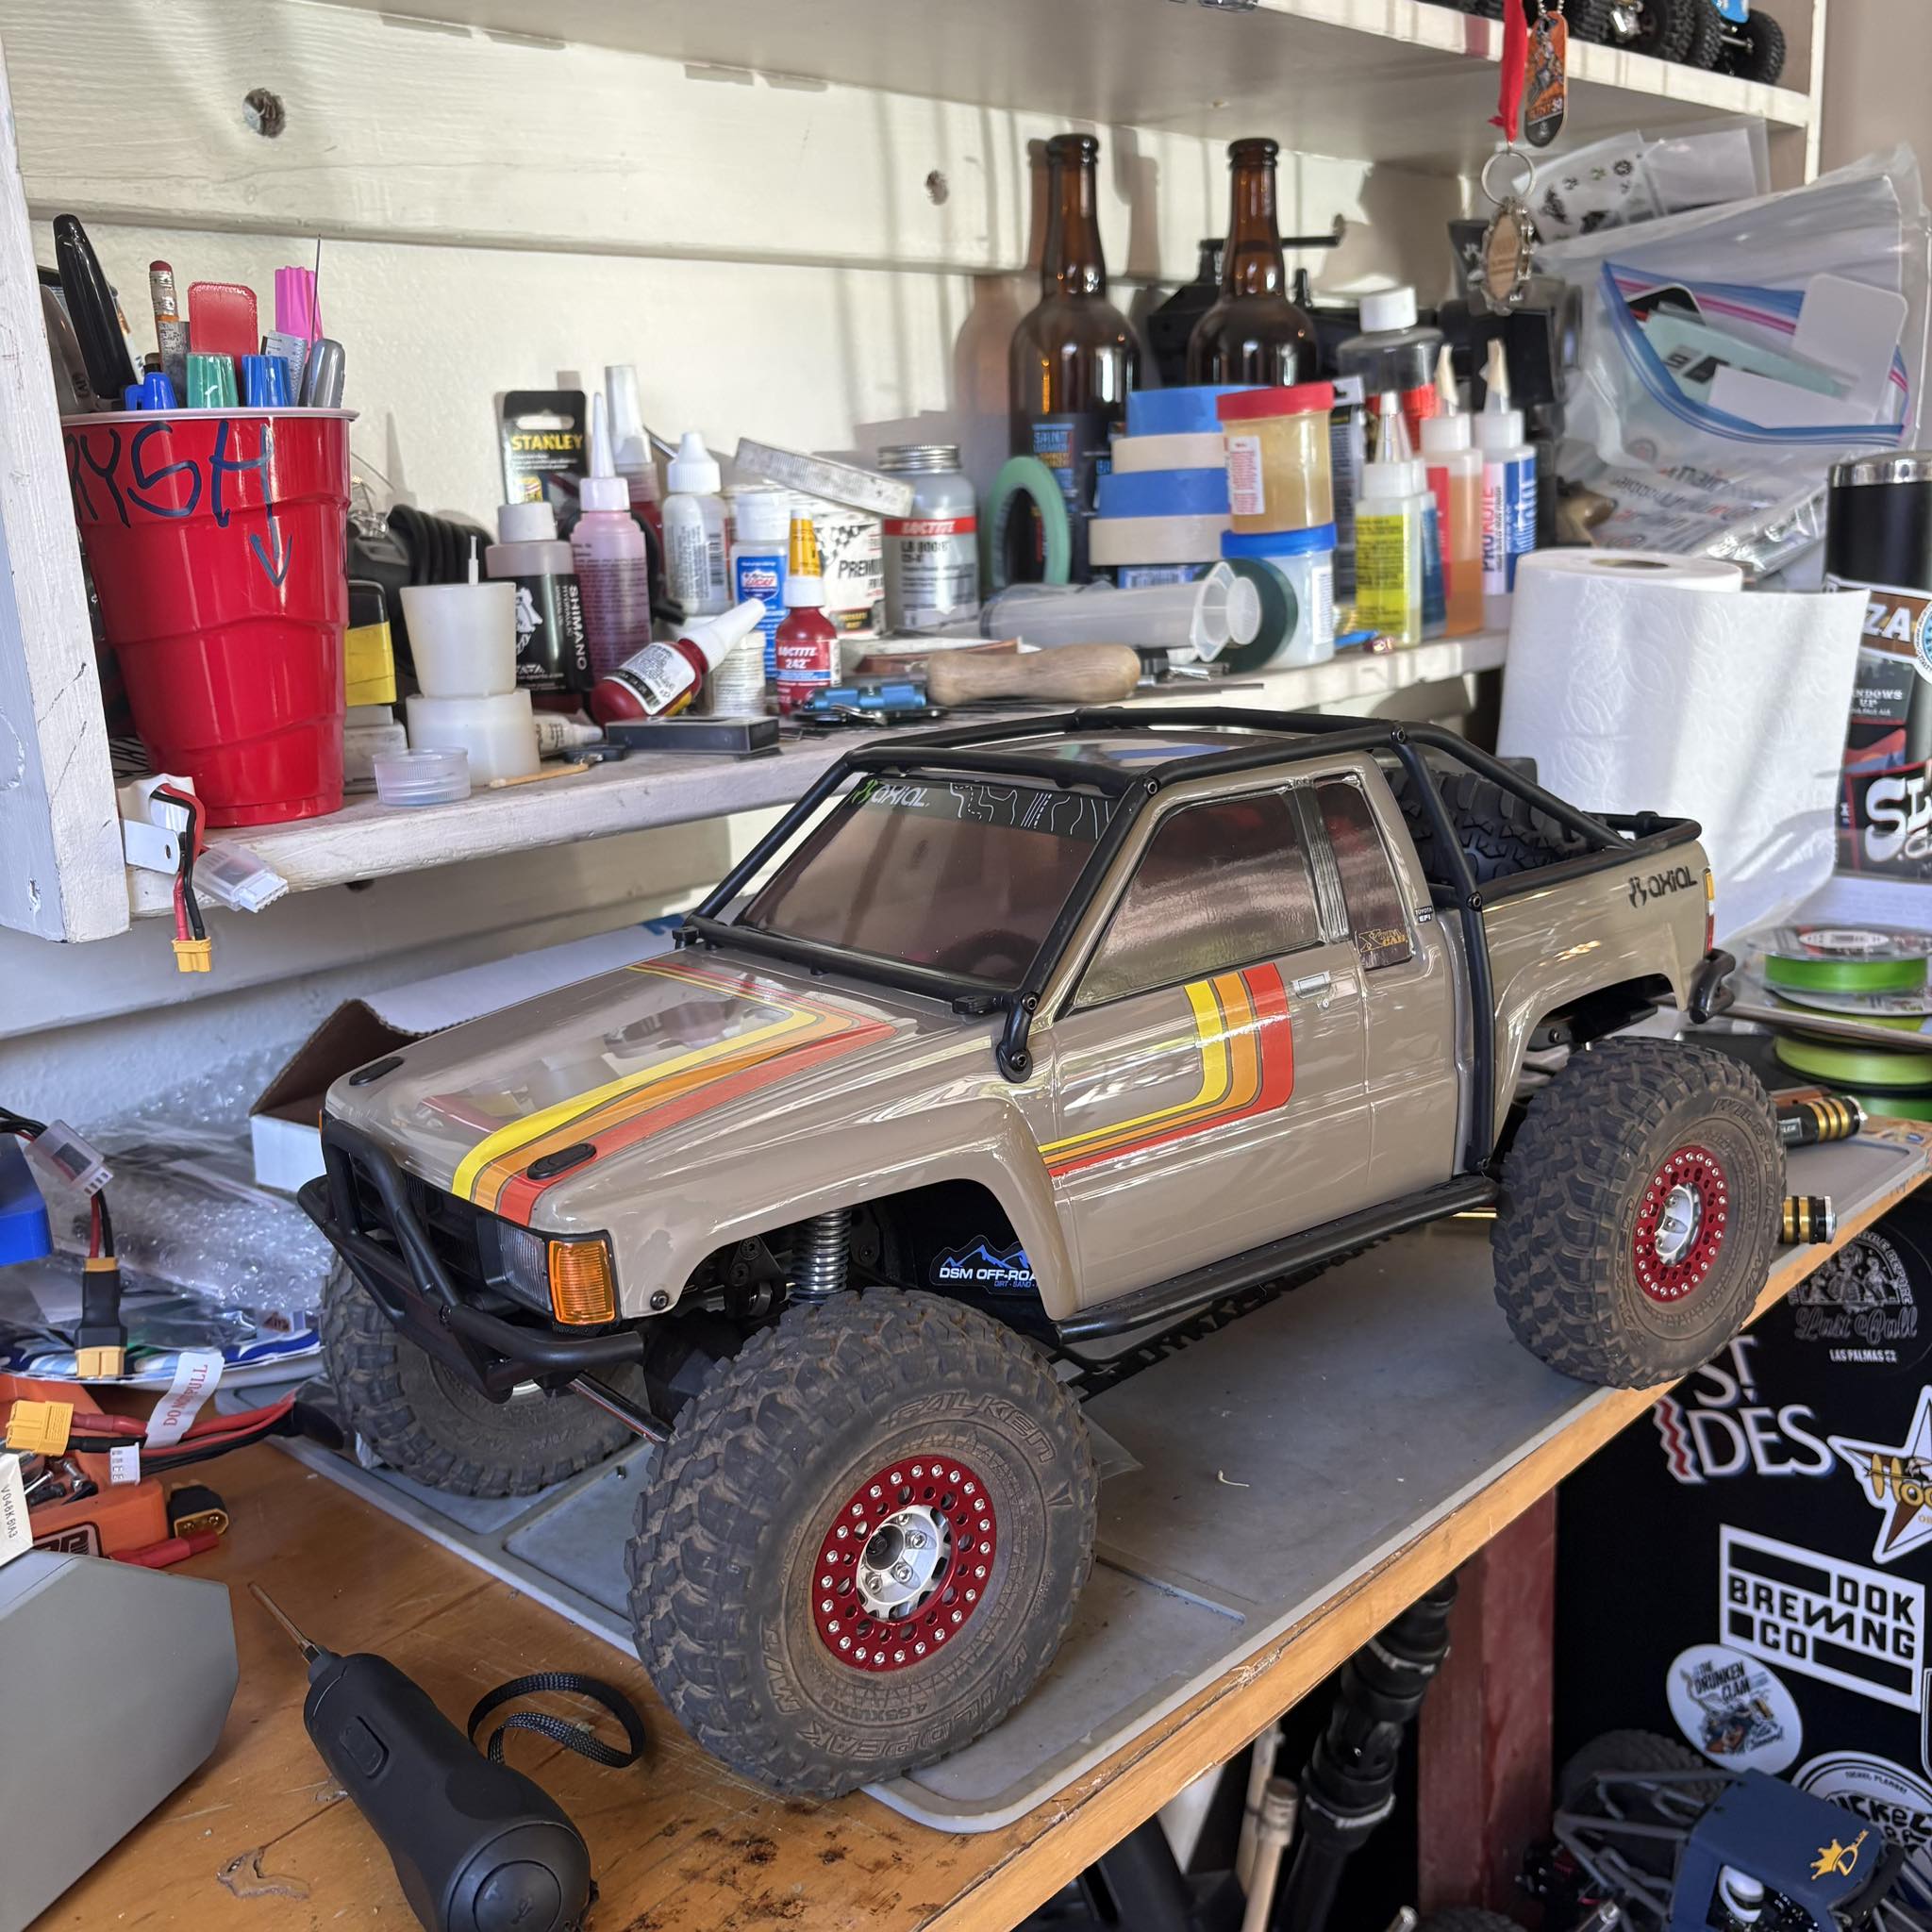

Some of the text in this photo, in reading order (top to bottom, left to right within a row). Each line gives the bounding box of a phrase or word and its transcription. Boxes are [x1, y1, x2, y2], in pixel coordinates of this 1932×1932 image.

[512, 435, 583, 451] STANLEY
[569, 585, 587, 671] SHIMANO
[777, 646, 818, 657] LOCTITE
[1415, 906, 1433, 915] TOYOTA
[1418, 914, 1431, 923] EFI
[940, 1267, 973, 1279] DSM
[1829, 1349, 1849, 1362] LAS
[1848, 1349, 1885, 1363] PALMAS
[163, 1409, 182, 1426] DO
[184, 1364, 208, 1396] PULL
[1759, 1619, 1807, 1660] CO
[1694, 1660, 1745, 1694] DRUNKEN
